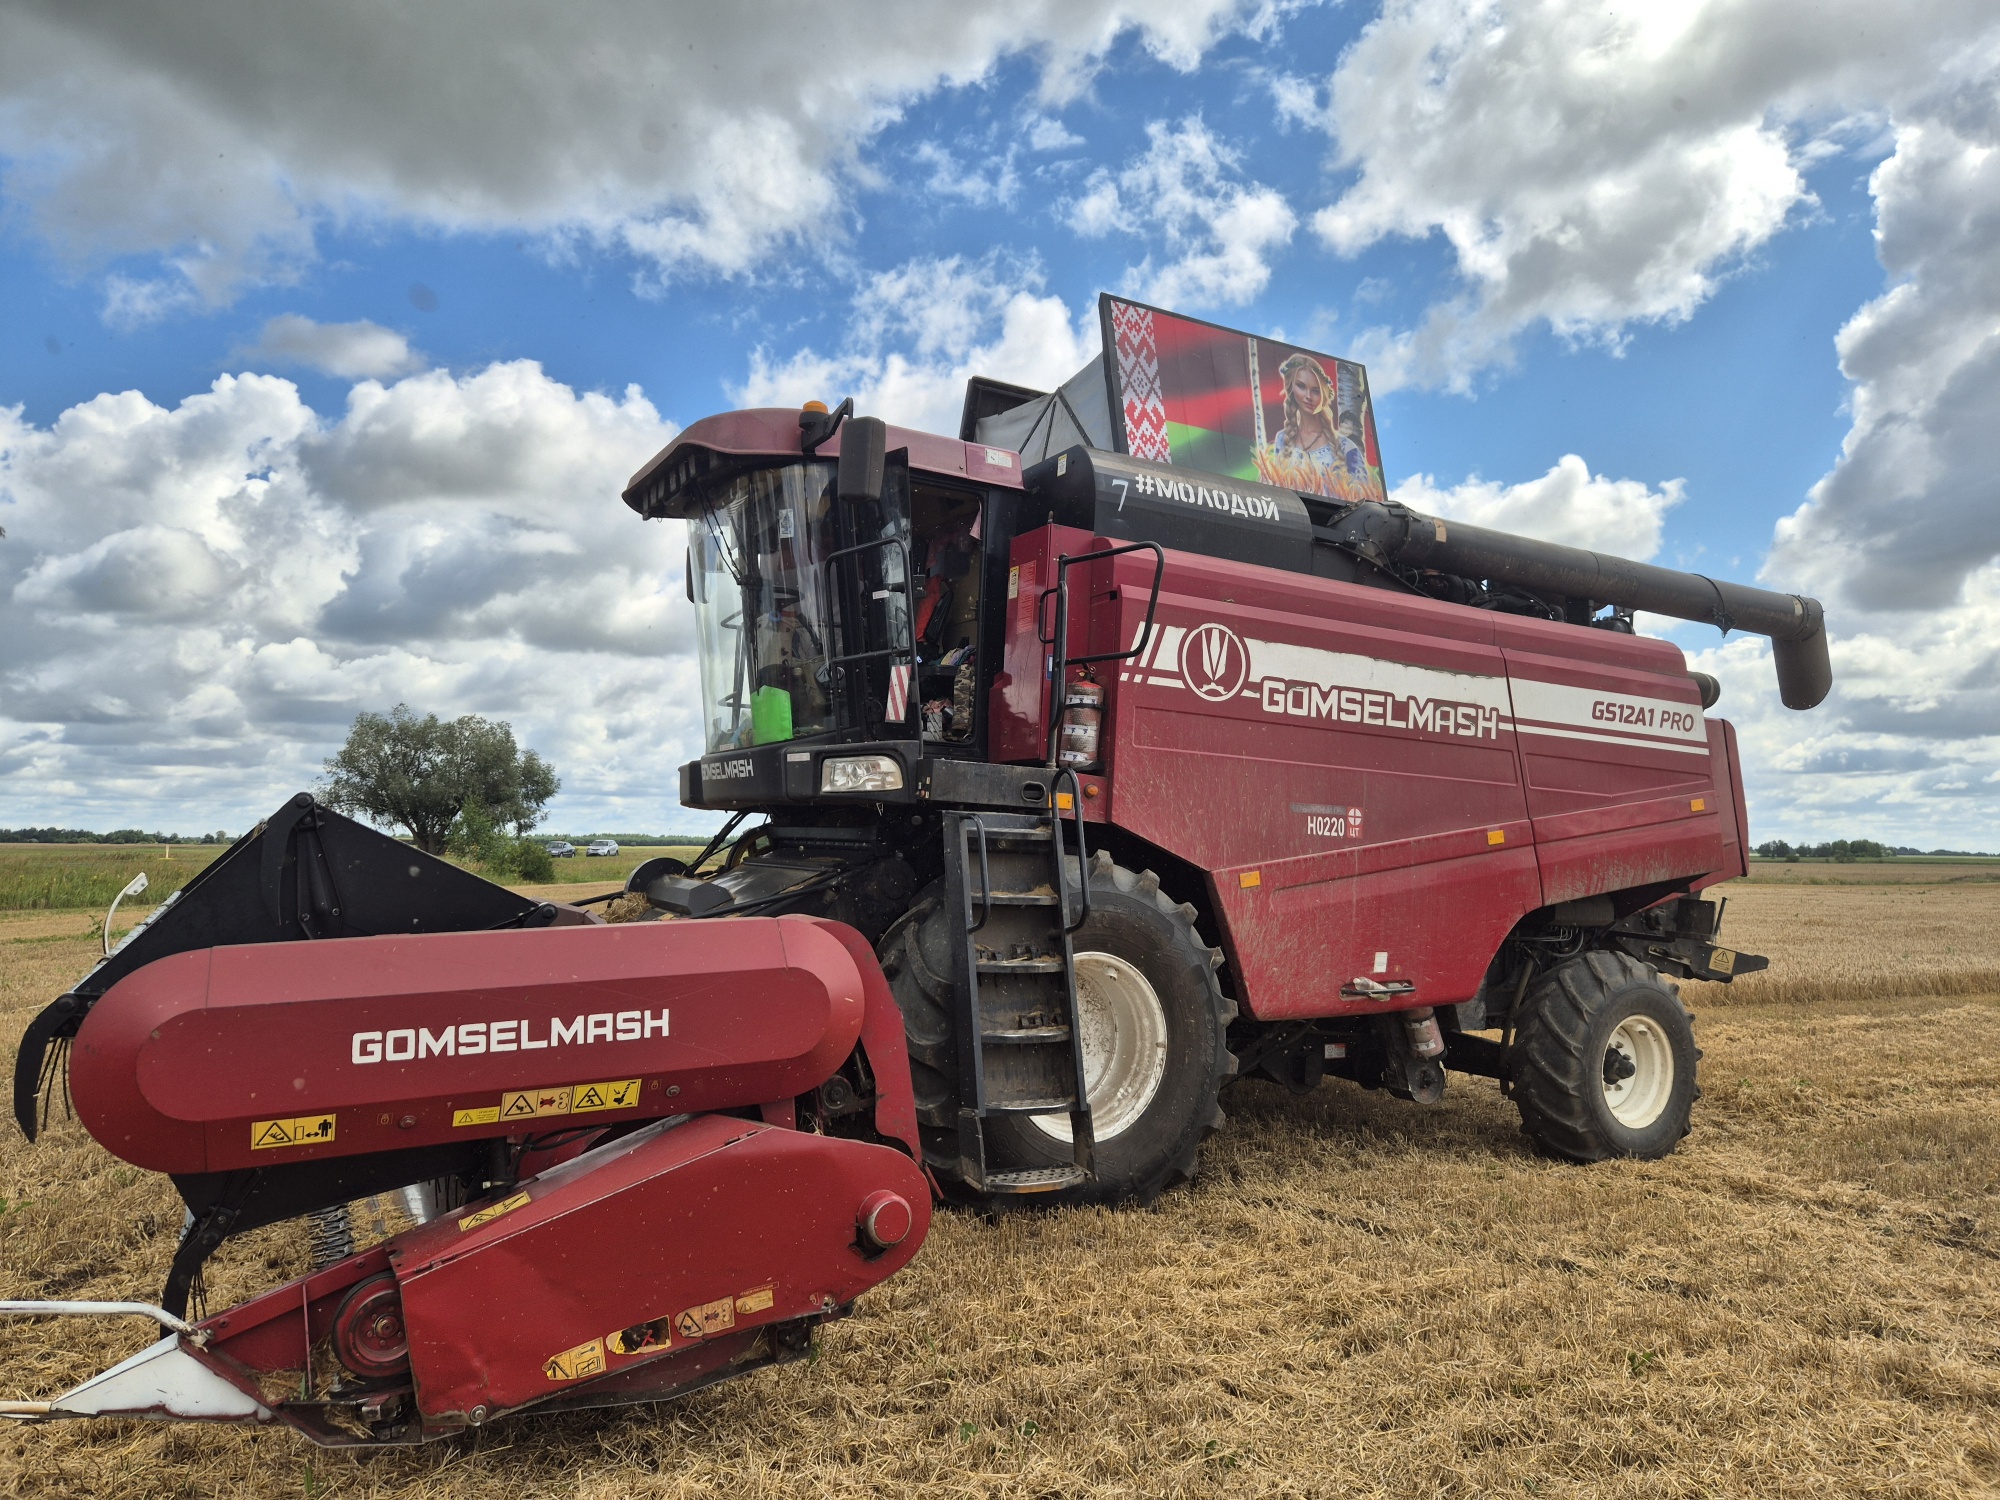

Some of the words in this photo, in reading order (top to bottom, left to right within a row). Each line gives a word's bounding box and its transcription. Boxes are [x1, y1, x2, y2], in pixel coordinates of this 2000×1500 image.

[1111, 479, 1129, 512] 7
[1135, 474, 1280, 521] #МОЛОДОЙ
[1262, 680, 1498, 739] GOMSELMASH
[1592, 701, 1655, 727] GS12A1
[1660, 710, 1695, 732] PRO
[351, 1009, 670, 1064] GOMSELMASH
